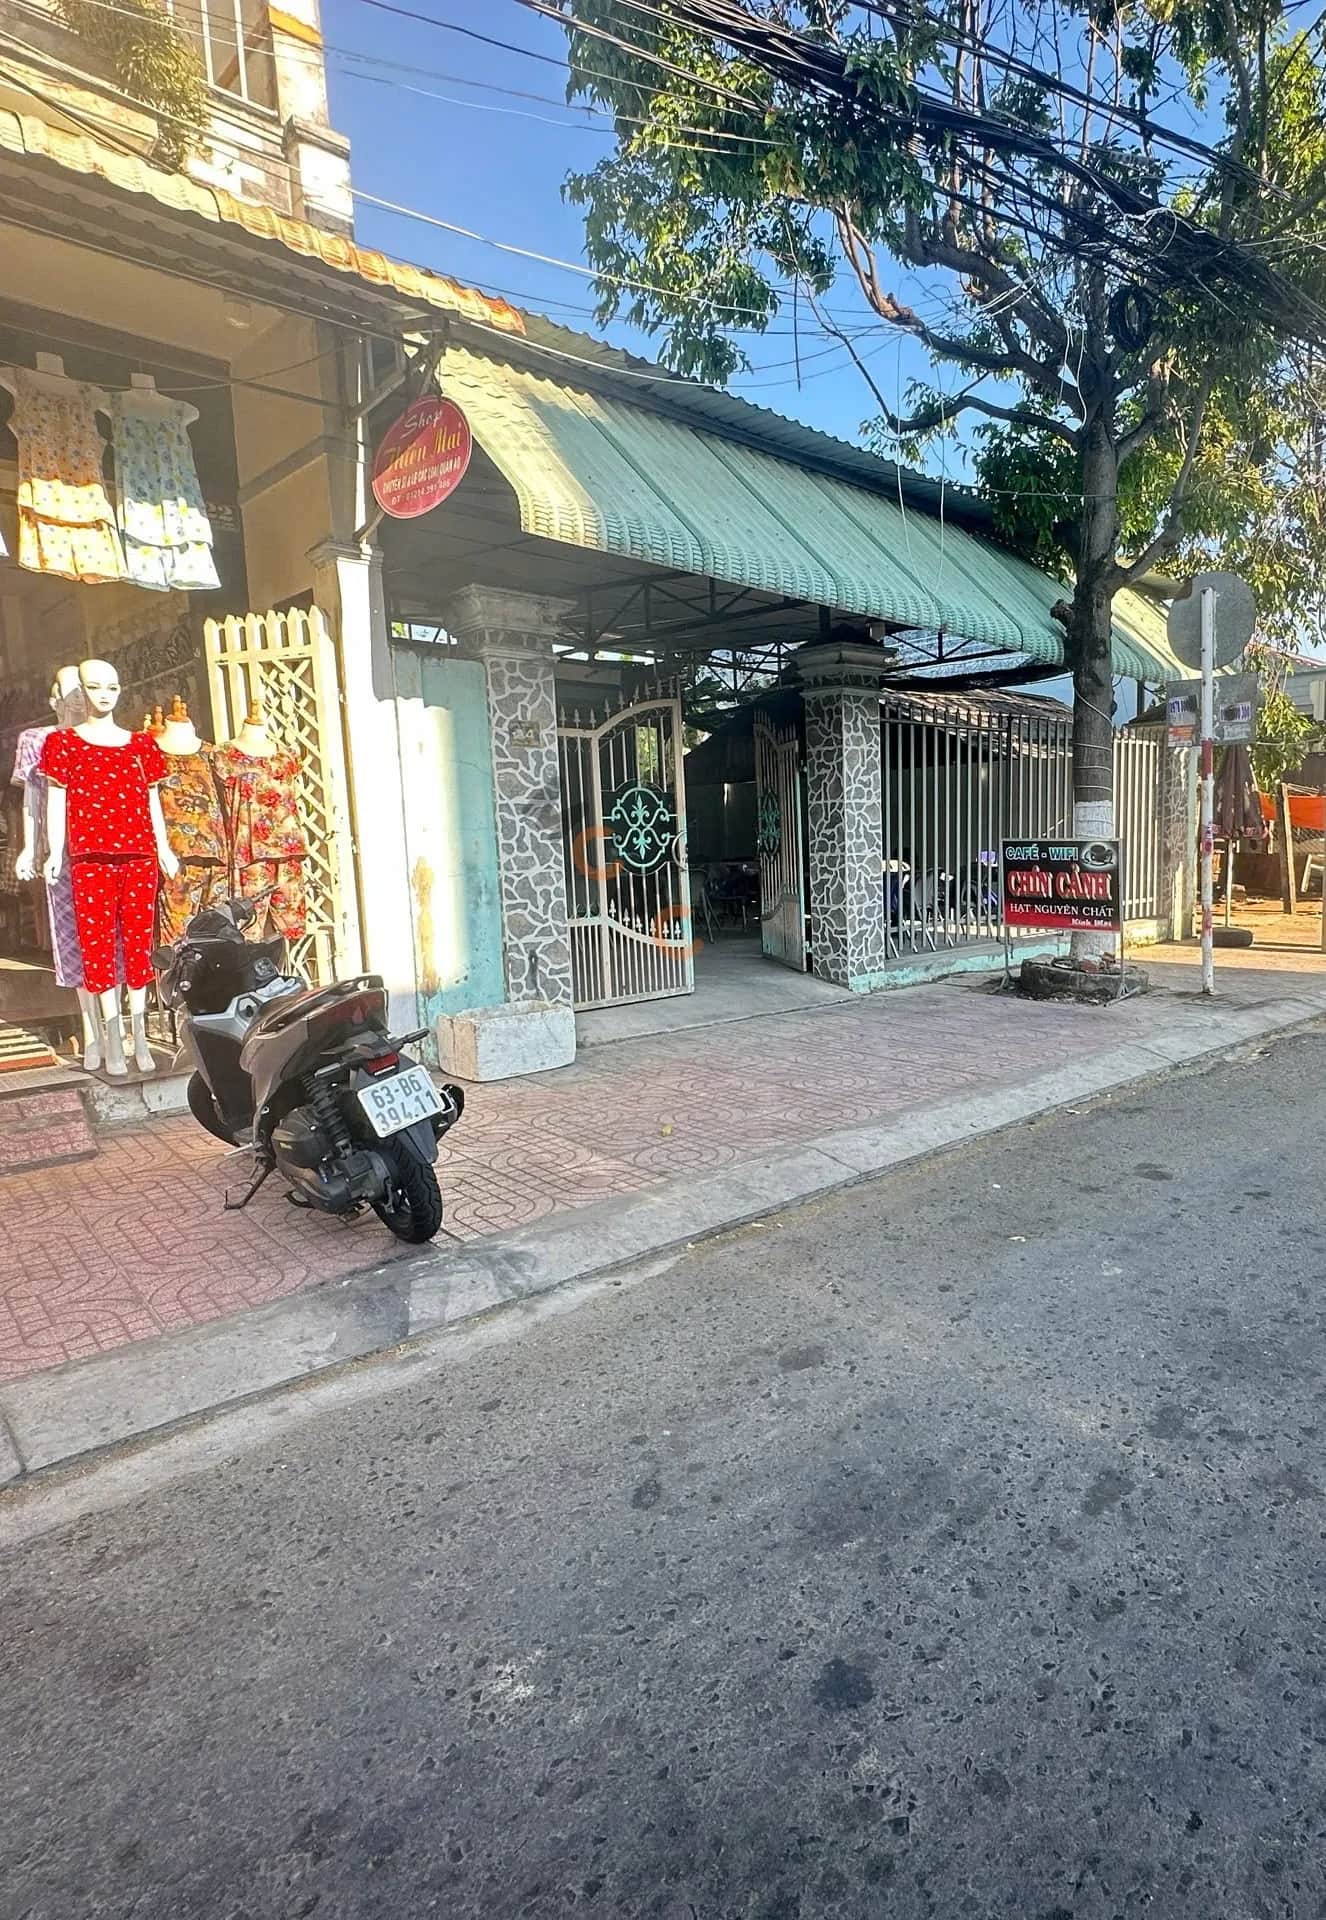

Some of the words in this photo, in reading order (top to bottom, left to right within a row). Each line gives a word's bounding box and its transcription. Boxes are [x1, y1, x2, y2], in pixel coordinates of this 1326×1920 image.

[401, 408, 443, 440] Shop
[1005, 843, 1040, 860] CAFÉ
[1048, 846, 1079, 861] WIFI
[1034, 903, 1079, 915] NGUYÊN
[1082, 904, 1114, 917] CHẤT
[371, 1074, 422, 1109] 63-B6
[376, 1090, 438, 1132] 394.11
